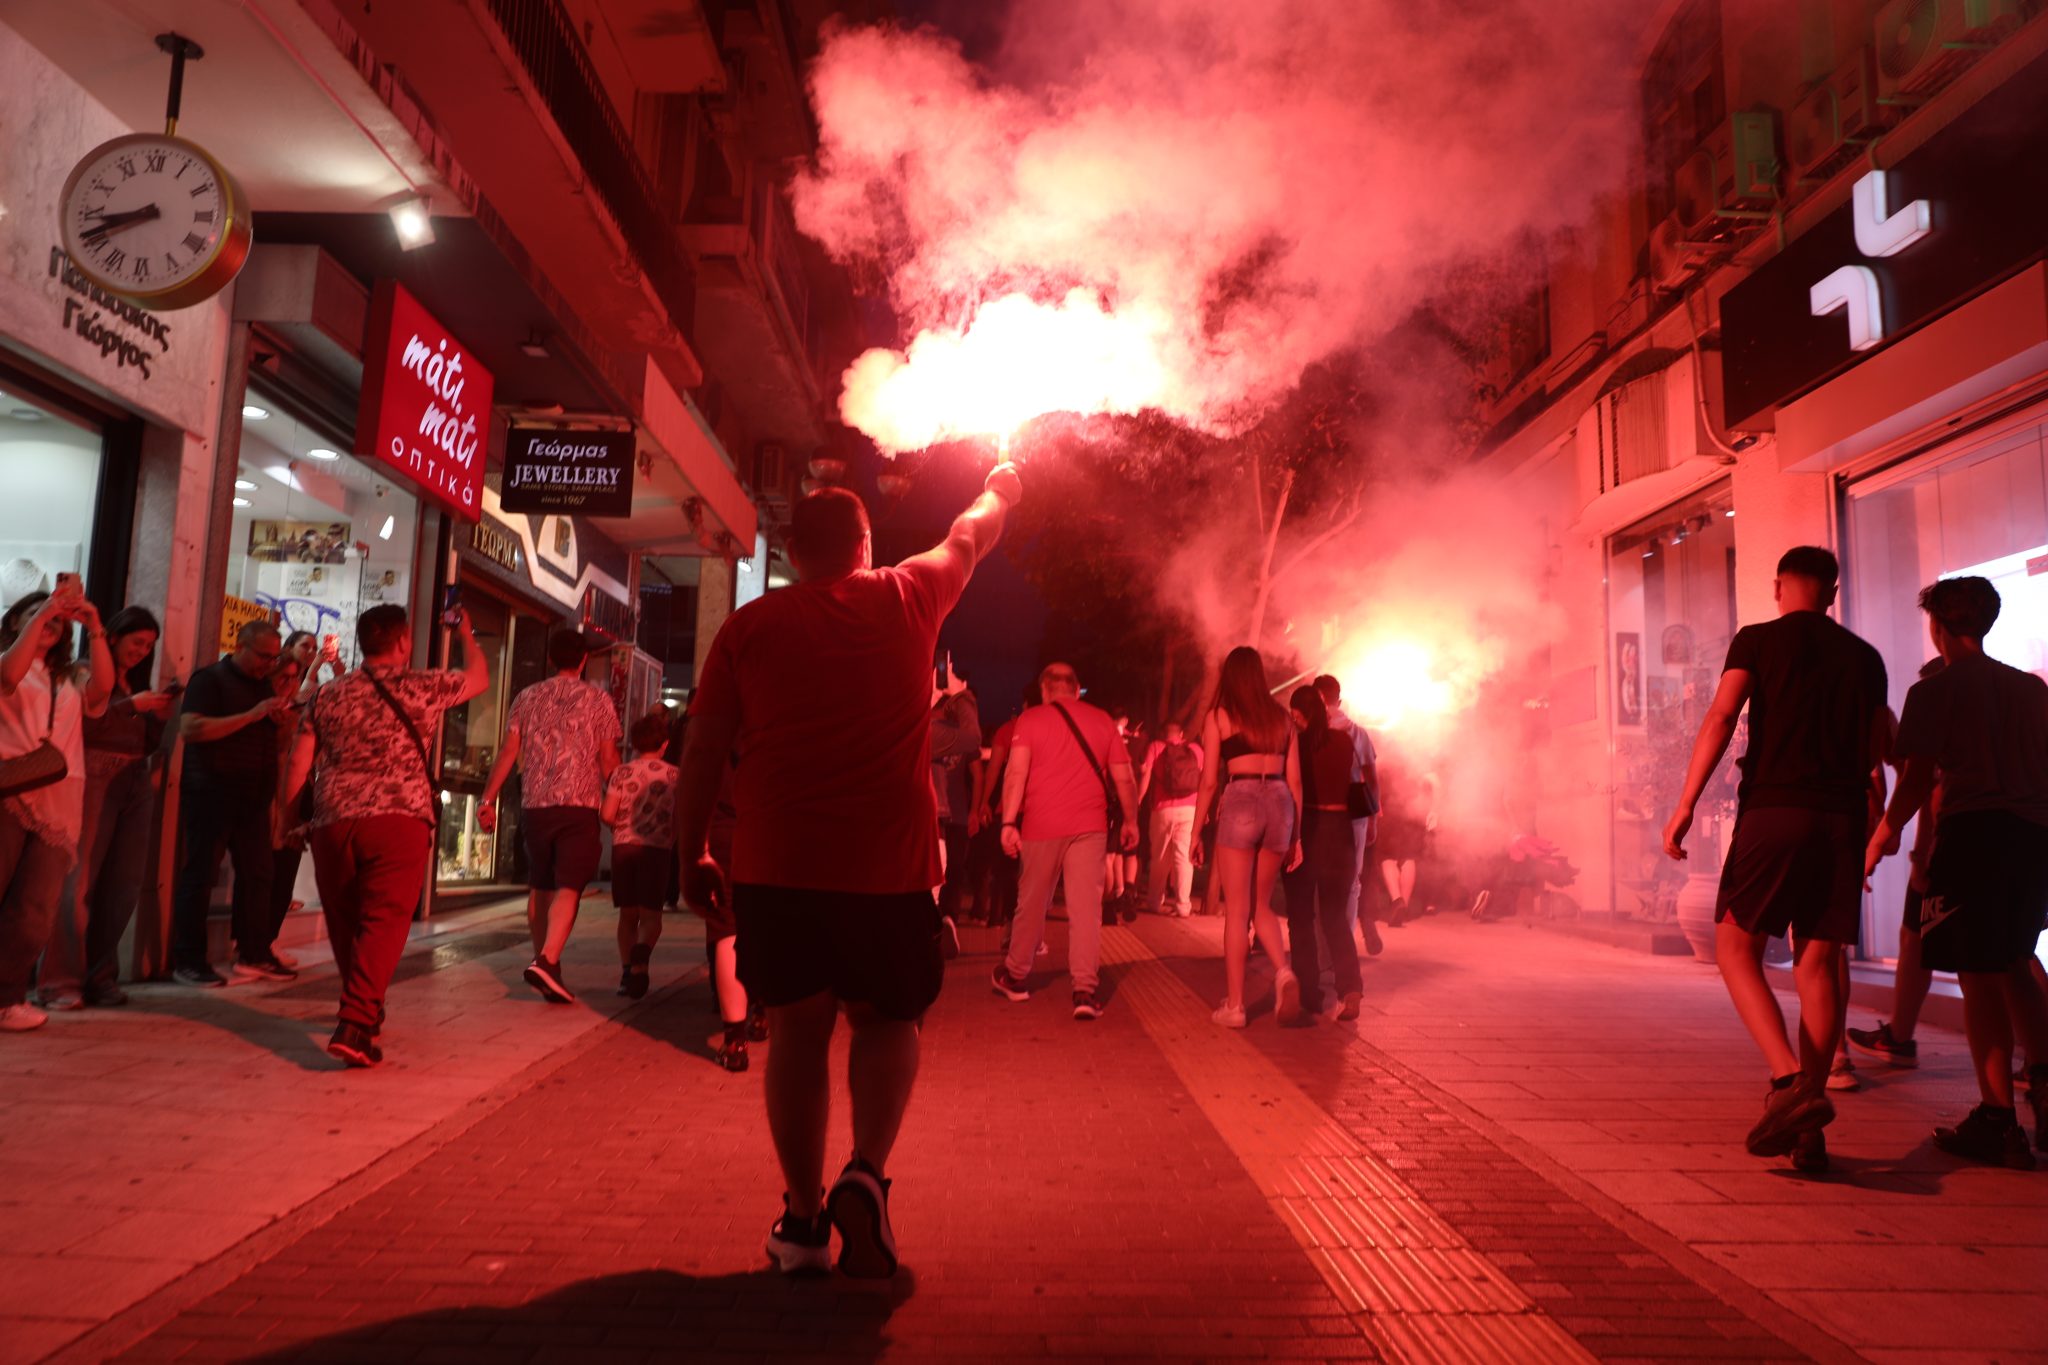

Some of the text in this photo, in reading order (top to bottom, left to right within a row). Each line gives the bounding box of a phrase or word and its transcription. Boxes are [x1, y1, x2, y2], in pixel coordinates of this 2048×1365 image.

[527, 438, 608, 461] Γεώρμας
[510, 464, 621, 488] JEWELLERY
[520, 482, 542, 491] SAME
[571, 484, 592, 493] SAME
[594, 485, 617, 493] PLACE
[541, 495, 587, 505] since 1967
[1920, 894, 1945, 922] IKE
